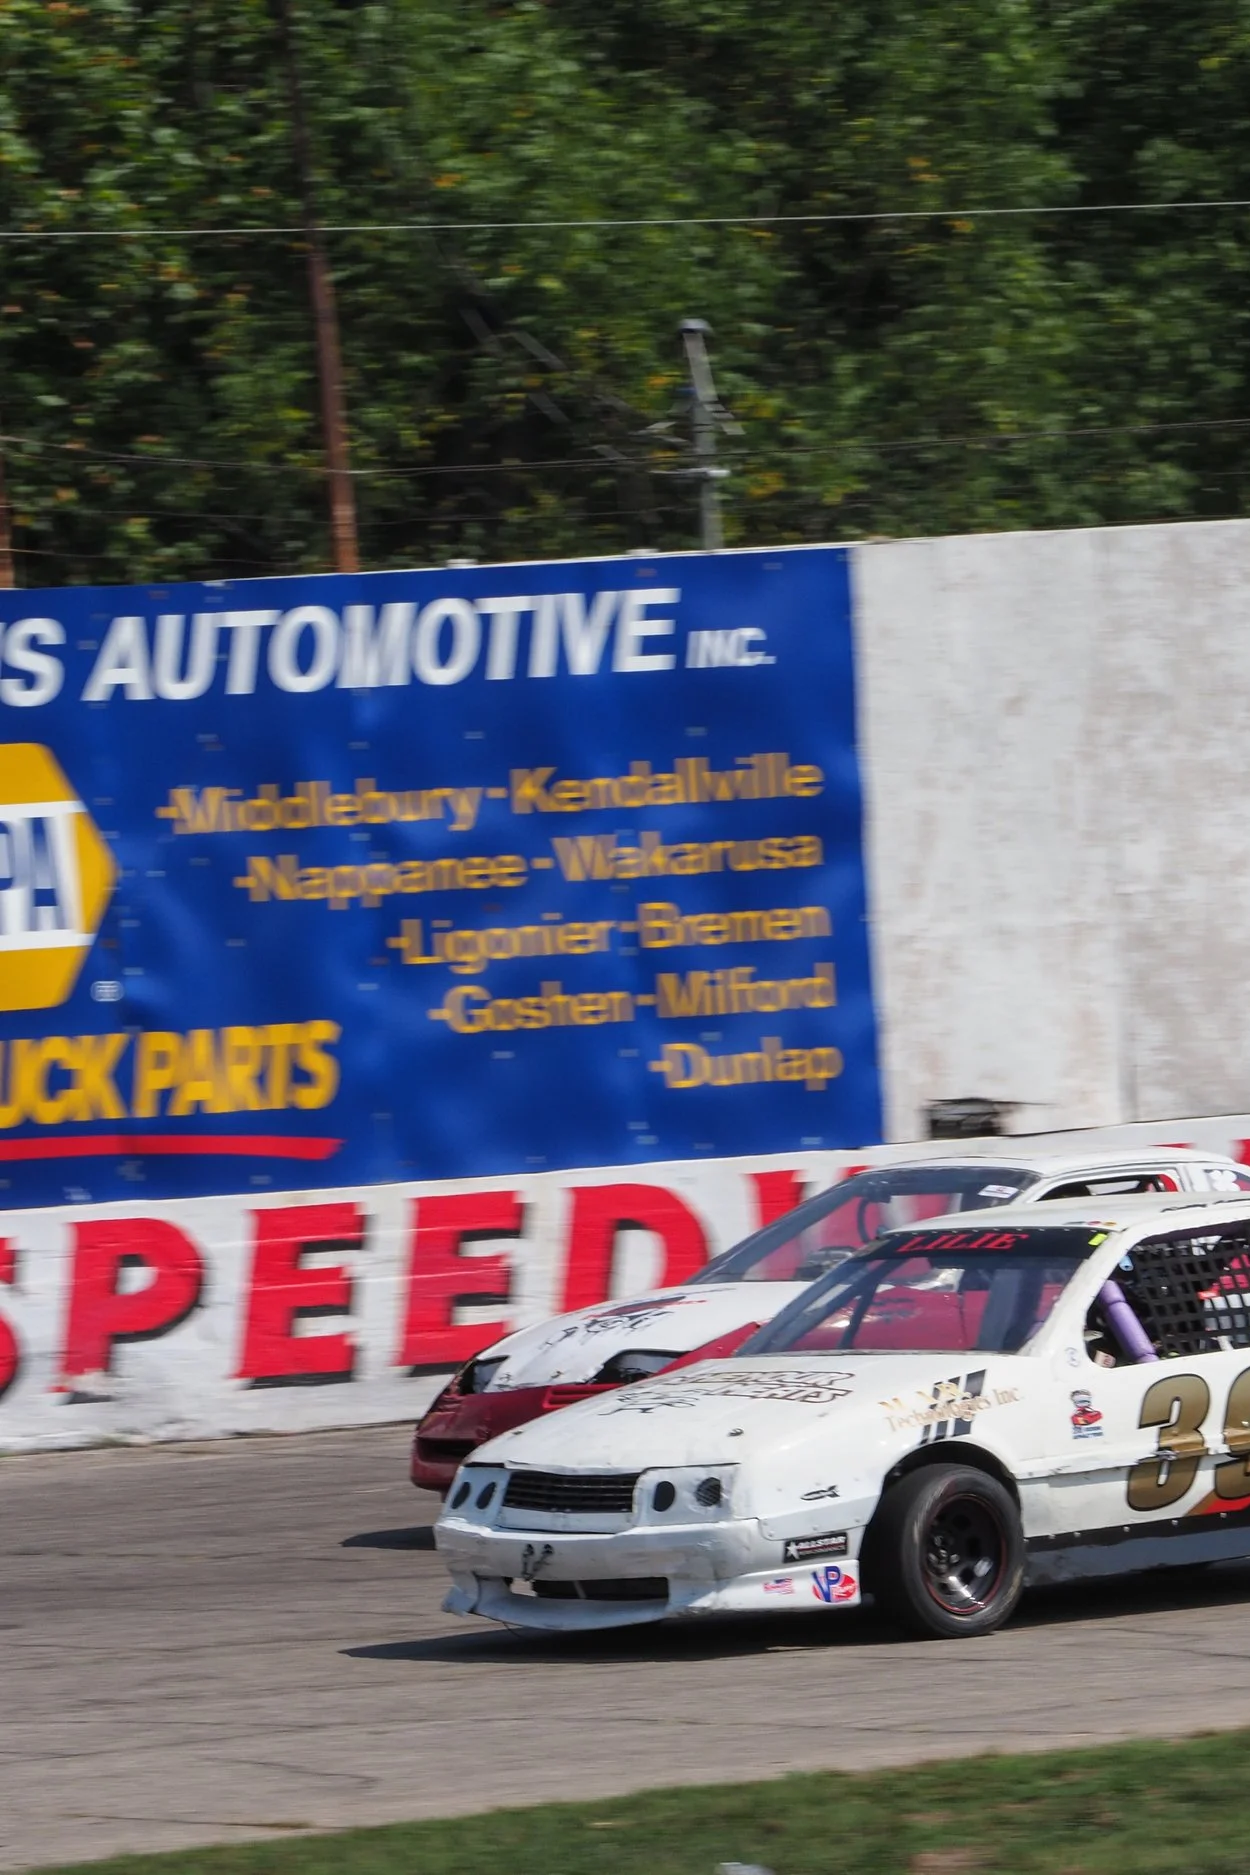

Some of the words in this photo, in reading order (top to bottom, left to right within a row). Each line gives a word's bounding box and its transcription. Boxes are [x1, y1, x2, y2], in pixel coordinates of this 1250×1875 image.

[0, 616, 67, 707] S
[80, 588, 682, 702] AUTOMOTIVE
[685, 627, 777, 668] INC.
[132, 1020, 343, 1118] PARTS
[811, 1565, 841, 1602] VP
